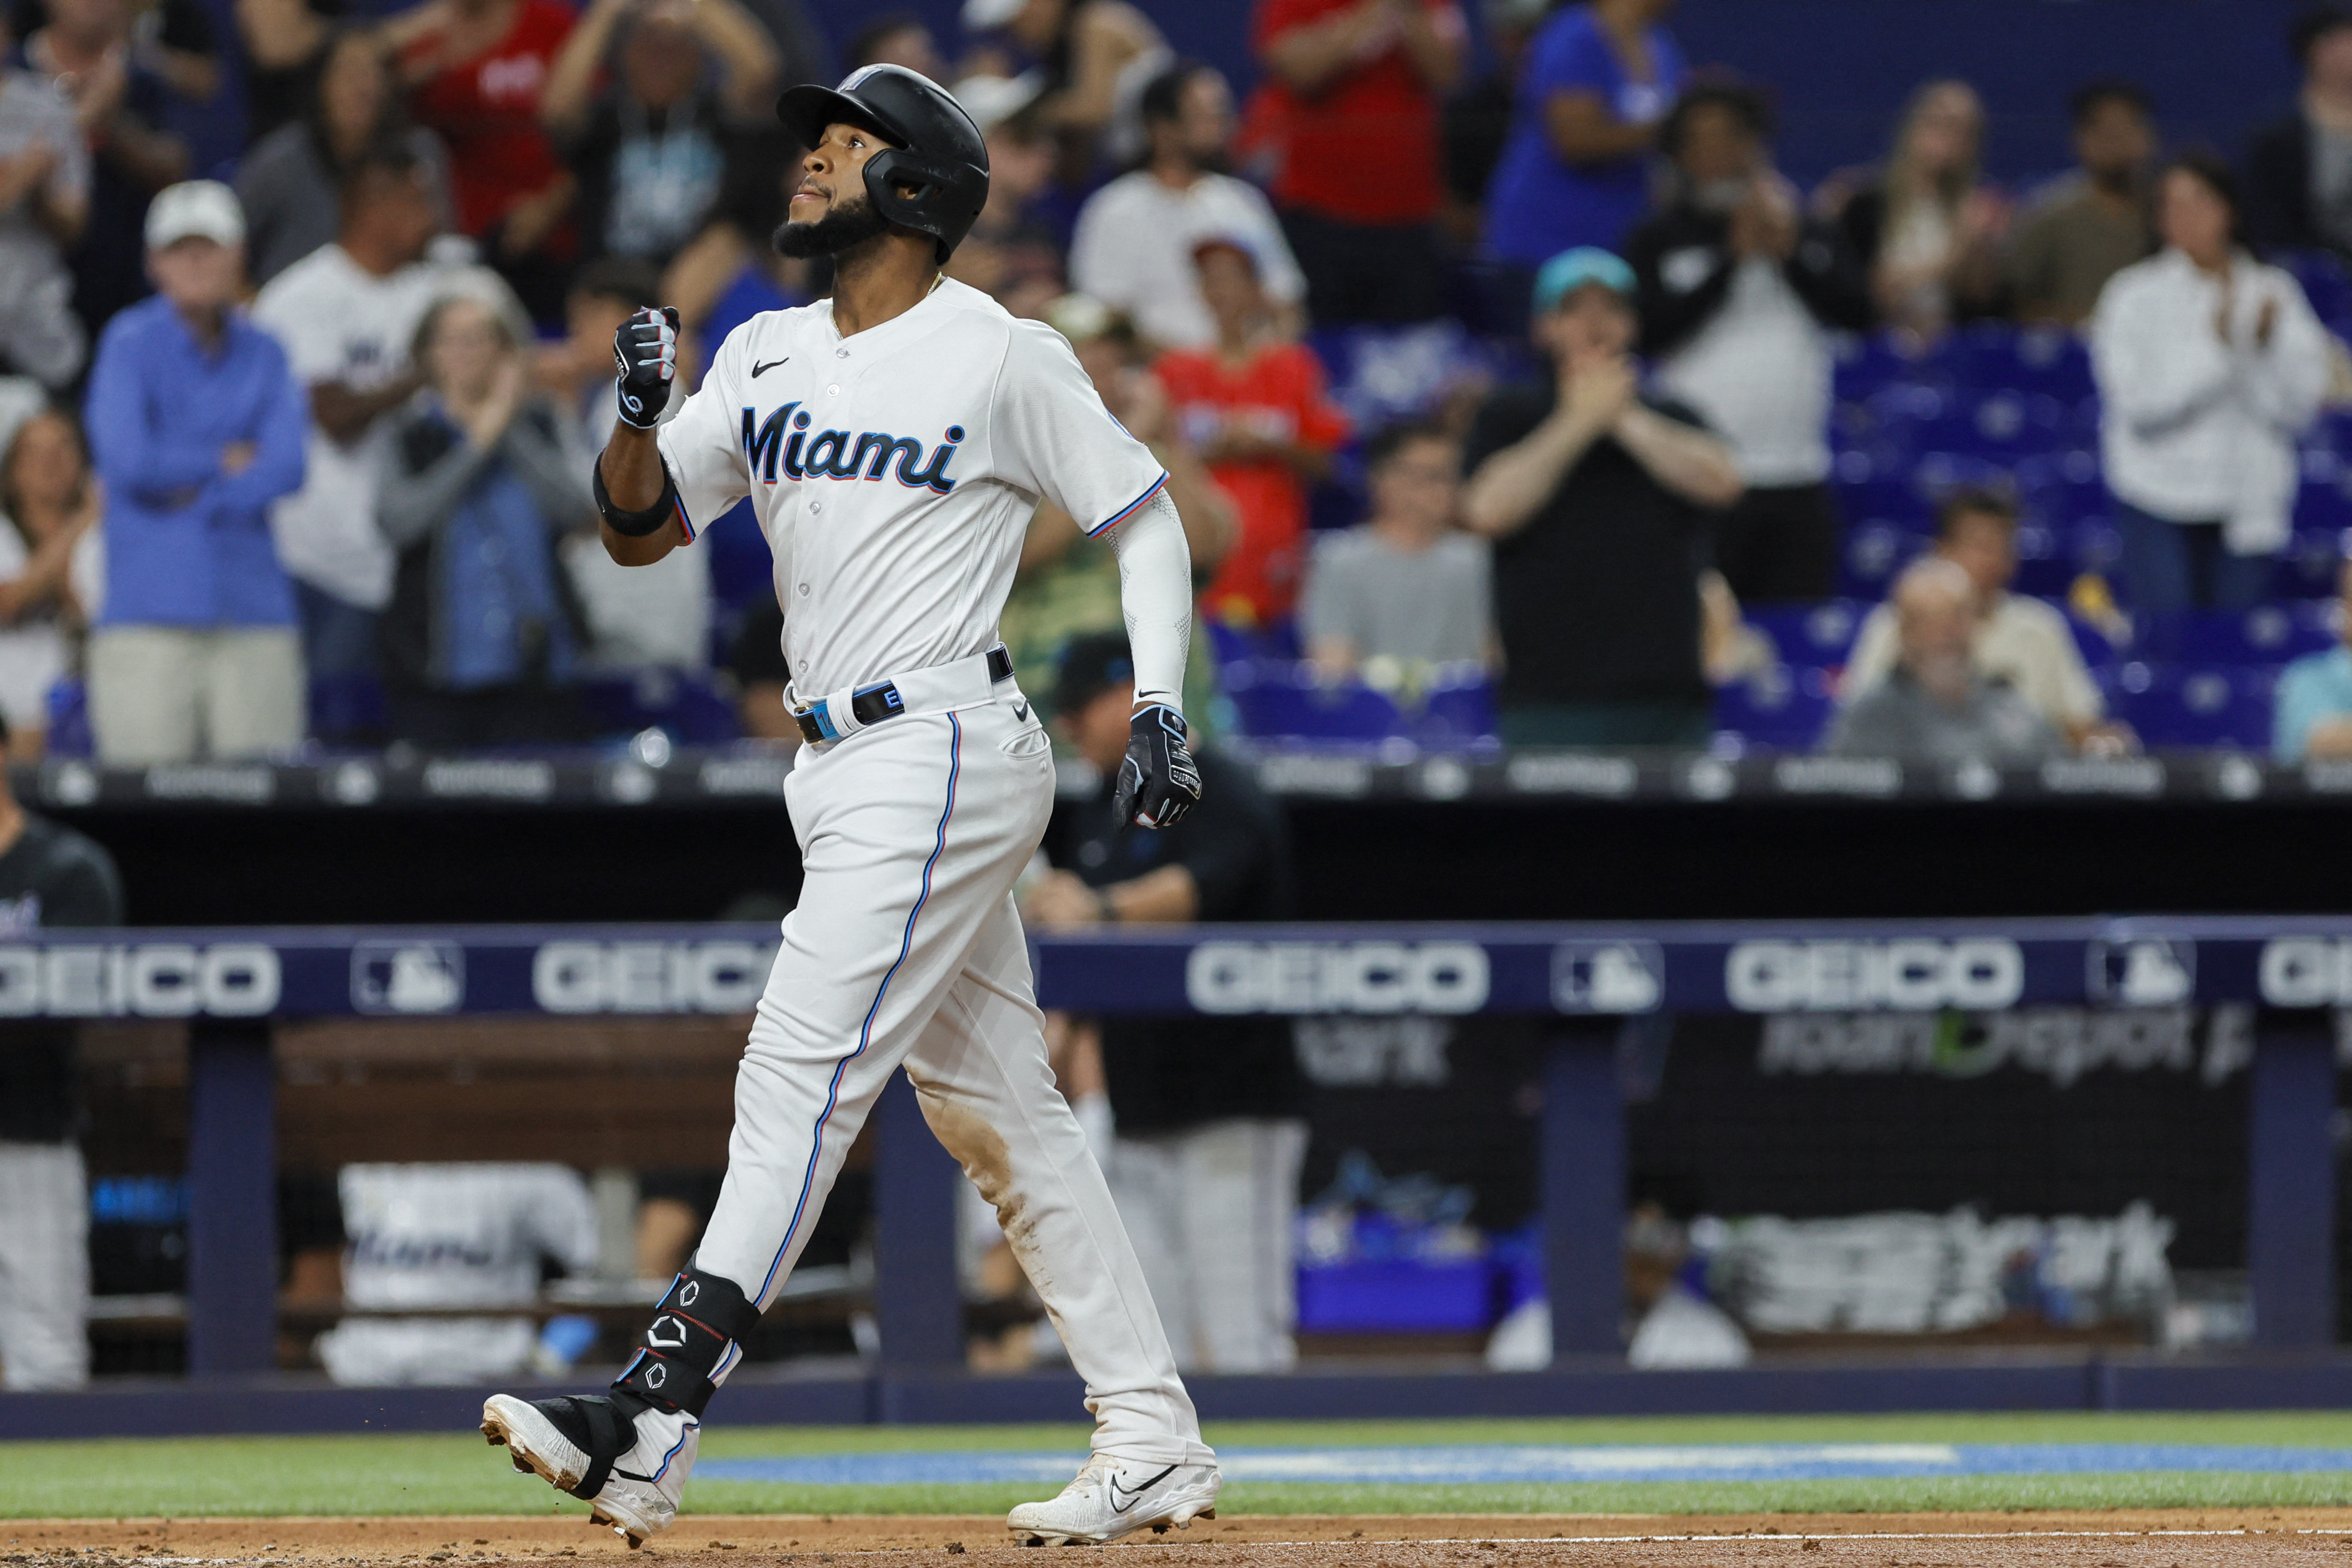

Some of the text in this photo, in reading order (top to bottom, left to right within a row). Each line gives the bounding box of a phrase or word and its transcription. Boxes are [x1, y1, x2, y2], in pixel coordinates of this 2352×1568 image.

[742, 401, 965, 495] Miami
[533, 942, 784, 1014] GEIC
[1185, 940, 1491, 1014] GEICO
[1725, 937, 2024, 1011] GEICO
